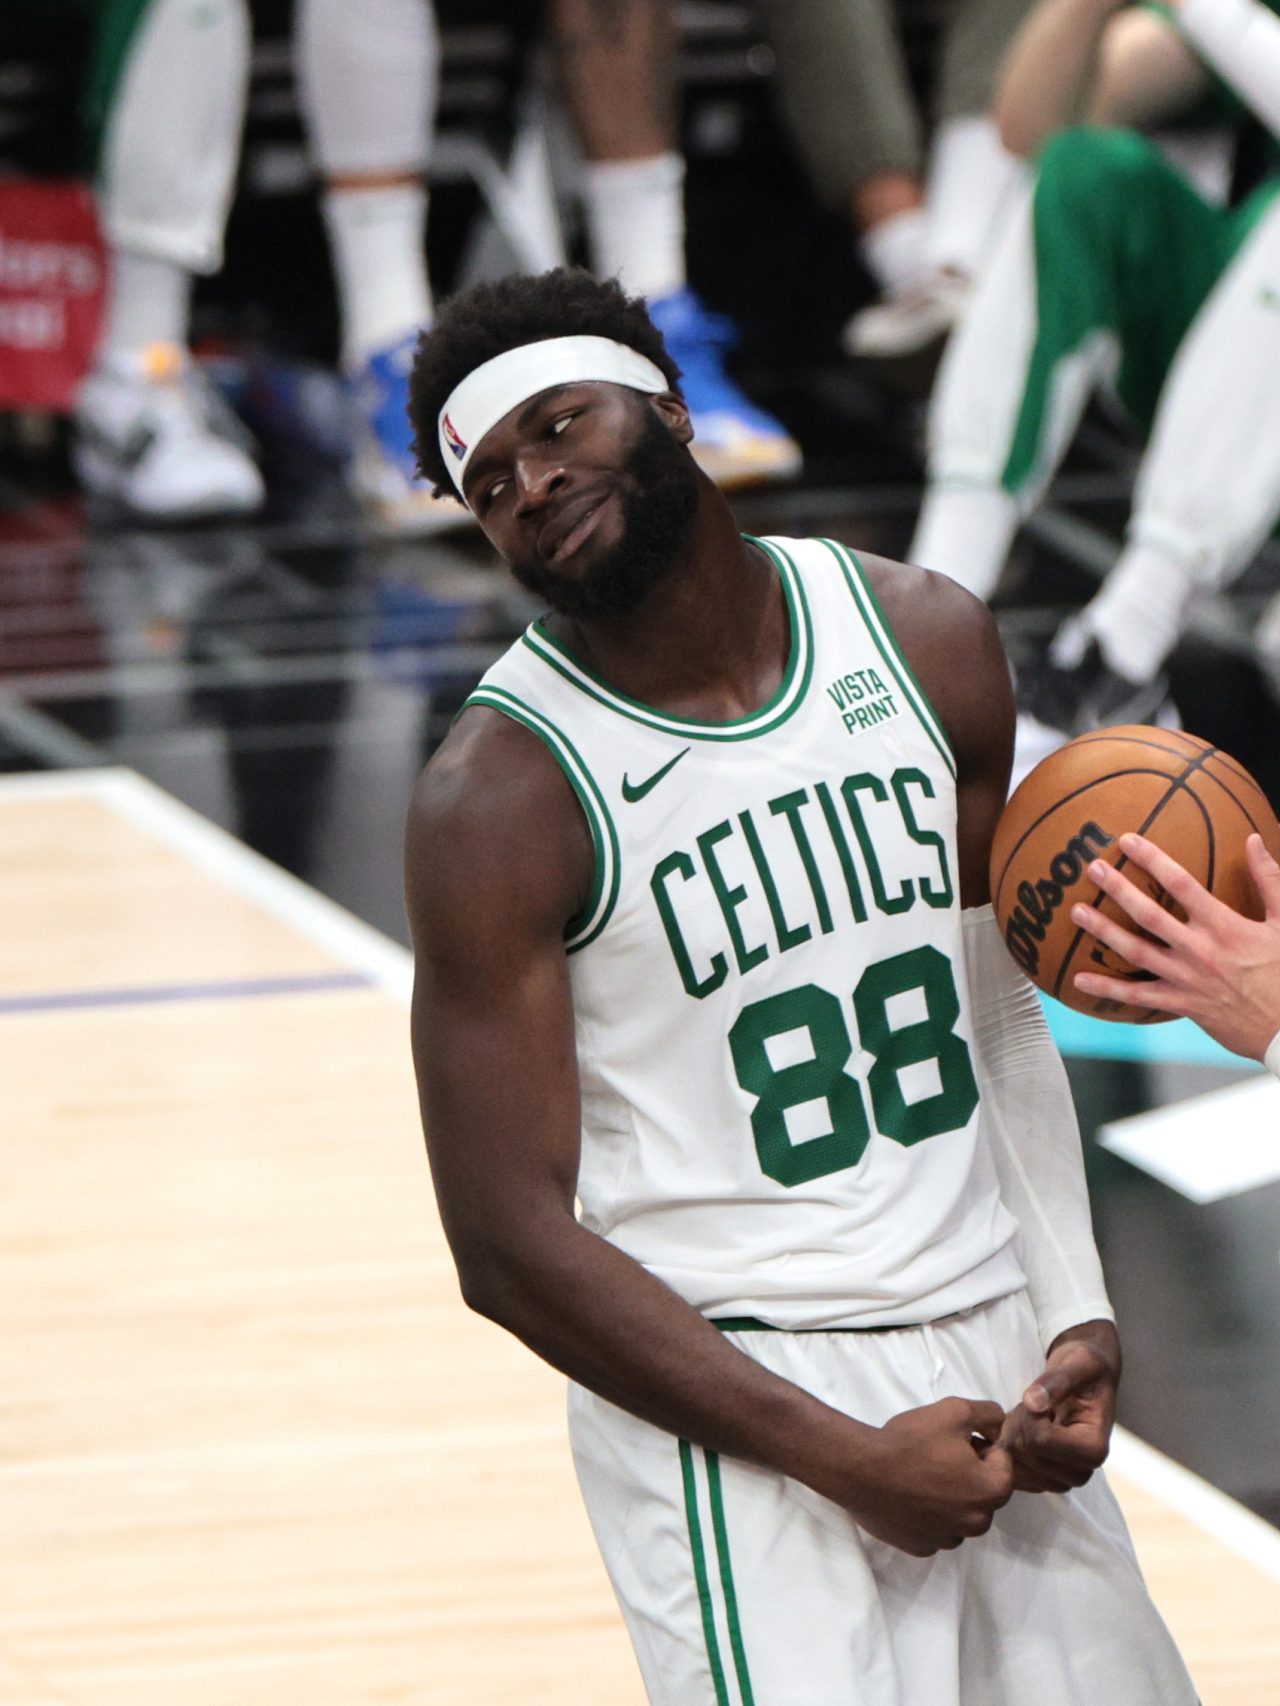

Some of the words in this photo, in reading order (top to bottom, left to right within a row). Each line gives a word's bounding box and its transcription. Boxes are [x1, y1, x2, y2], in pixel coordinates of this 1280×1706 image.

[826, 668, 889, 711] VISTA
[842, 695, 898, 734] PRINT
[650, 767, 954, 1000] CELTICS
[727, 944, 980, 1188] 88
